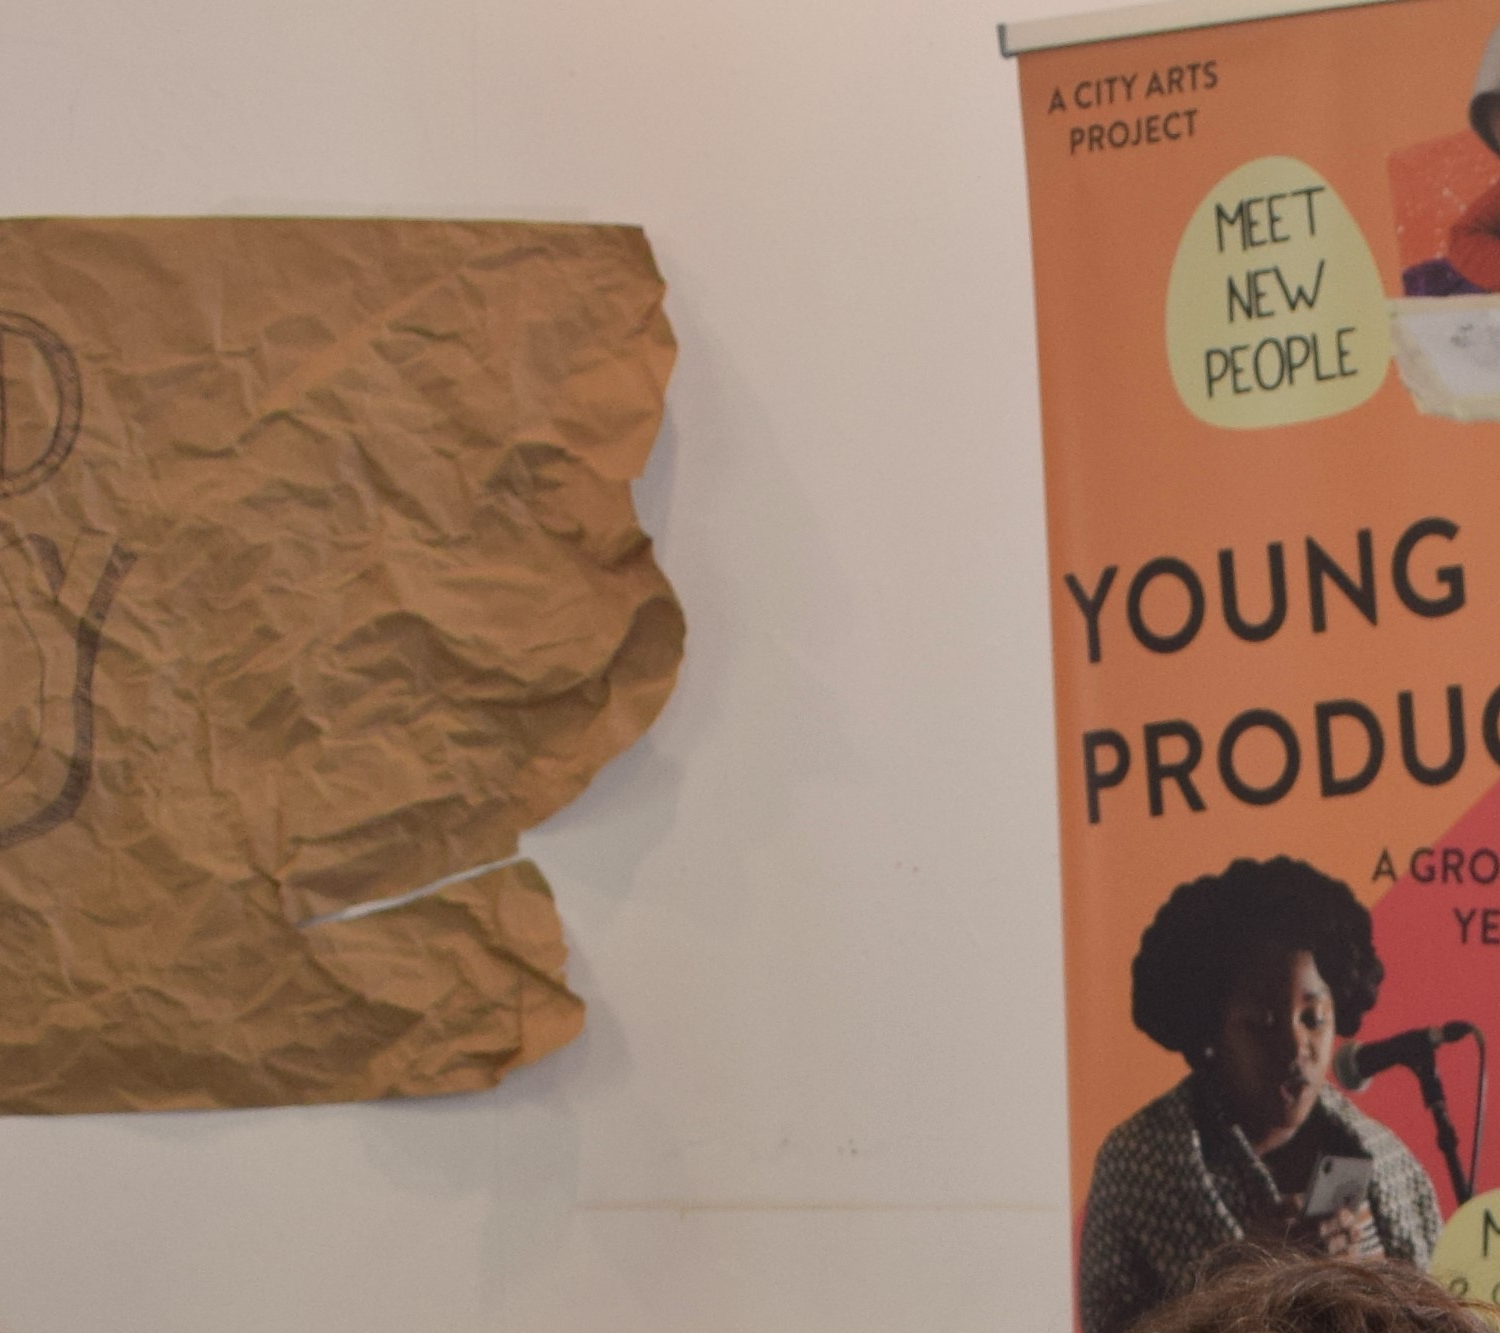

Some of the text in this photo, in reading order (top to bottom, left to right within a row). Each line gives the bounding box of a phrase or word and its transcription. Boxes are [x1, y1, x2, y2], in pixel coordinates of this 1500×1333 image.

[1048, 62, 1219, 115] A CITY ARTS
[1069, 110, 1198, 157] PROJECT
[1214, 186, 1327, 254] MEET
[1226, 260, 1327, 324] NEW
[1204, 327, 1359, 399] PEOPLE
[1063, 516, 1468, 665] YOUNG
[1371, 848, 1399, 883] A
